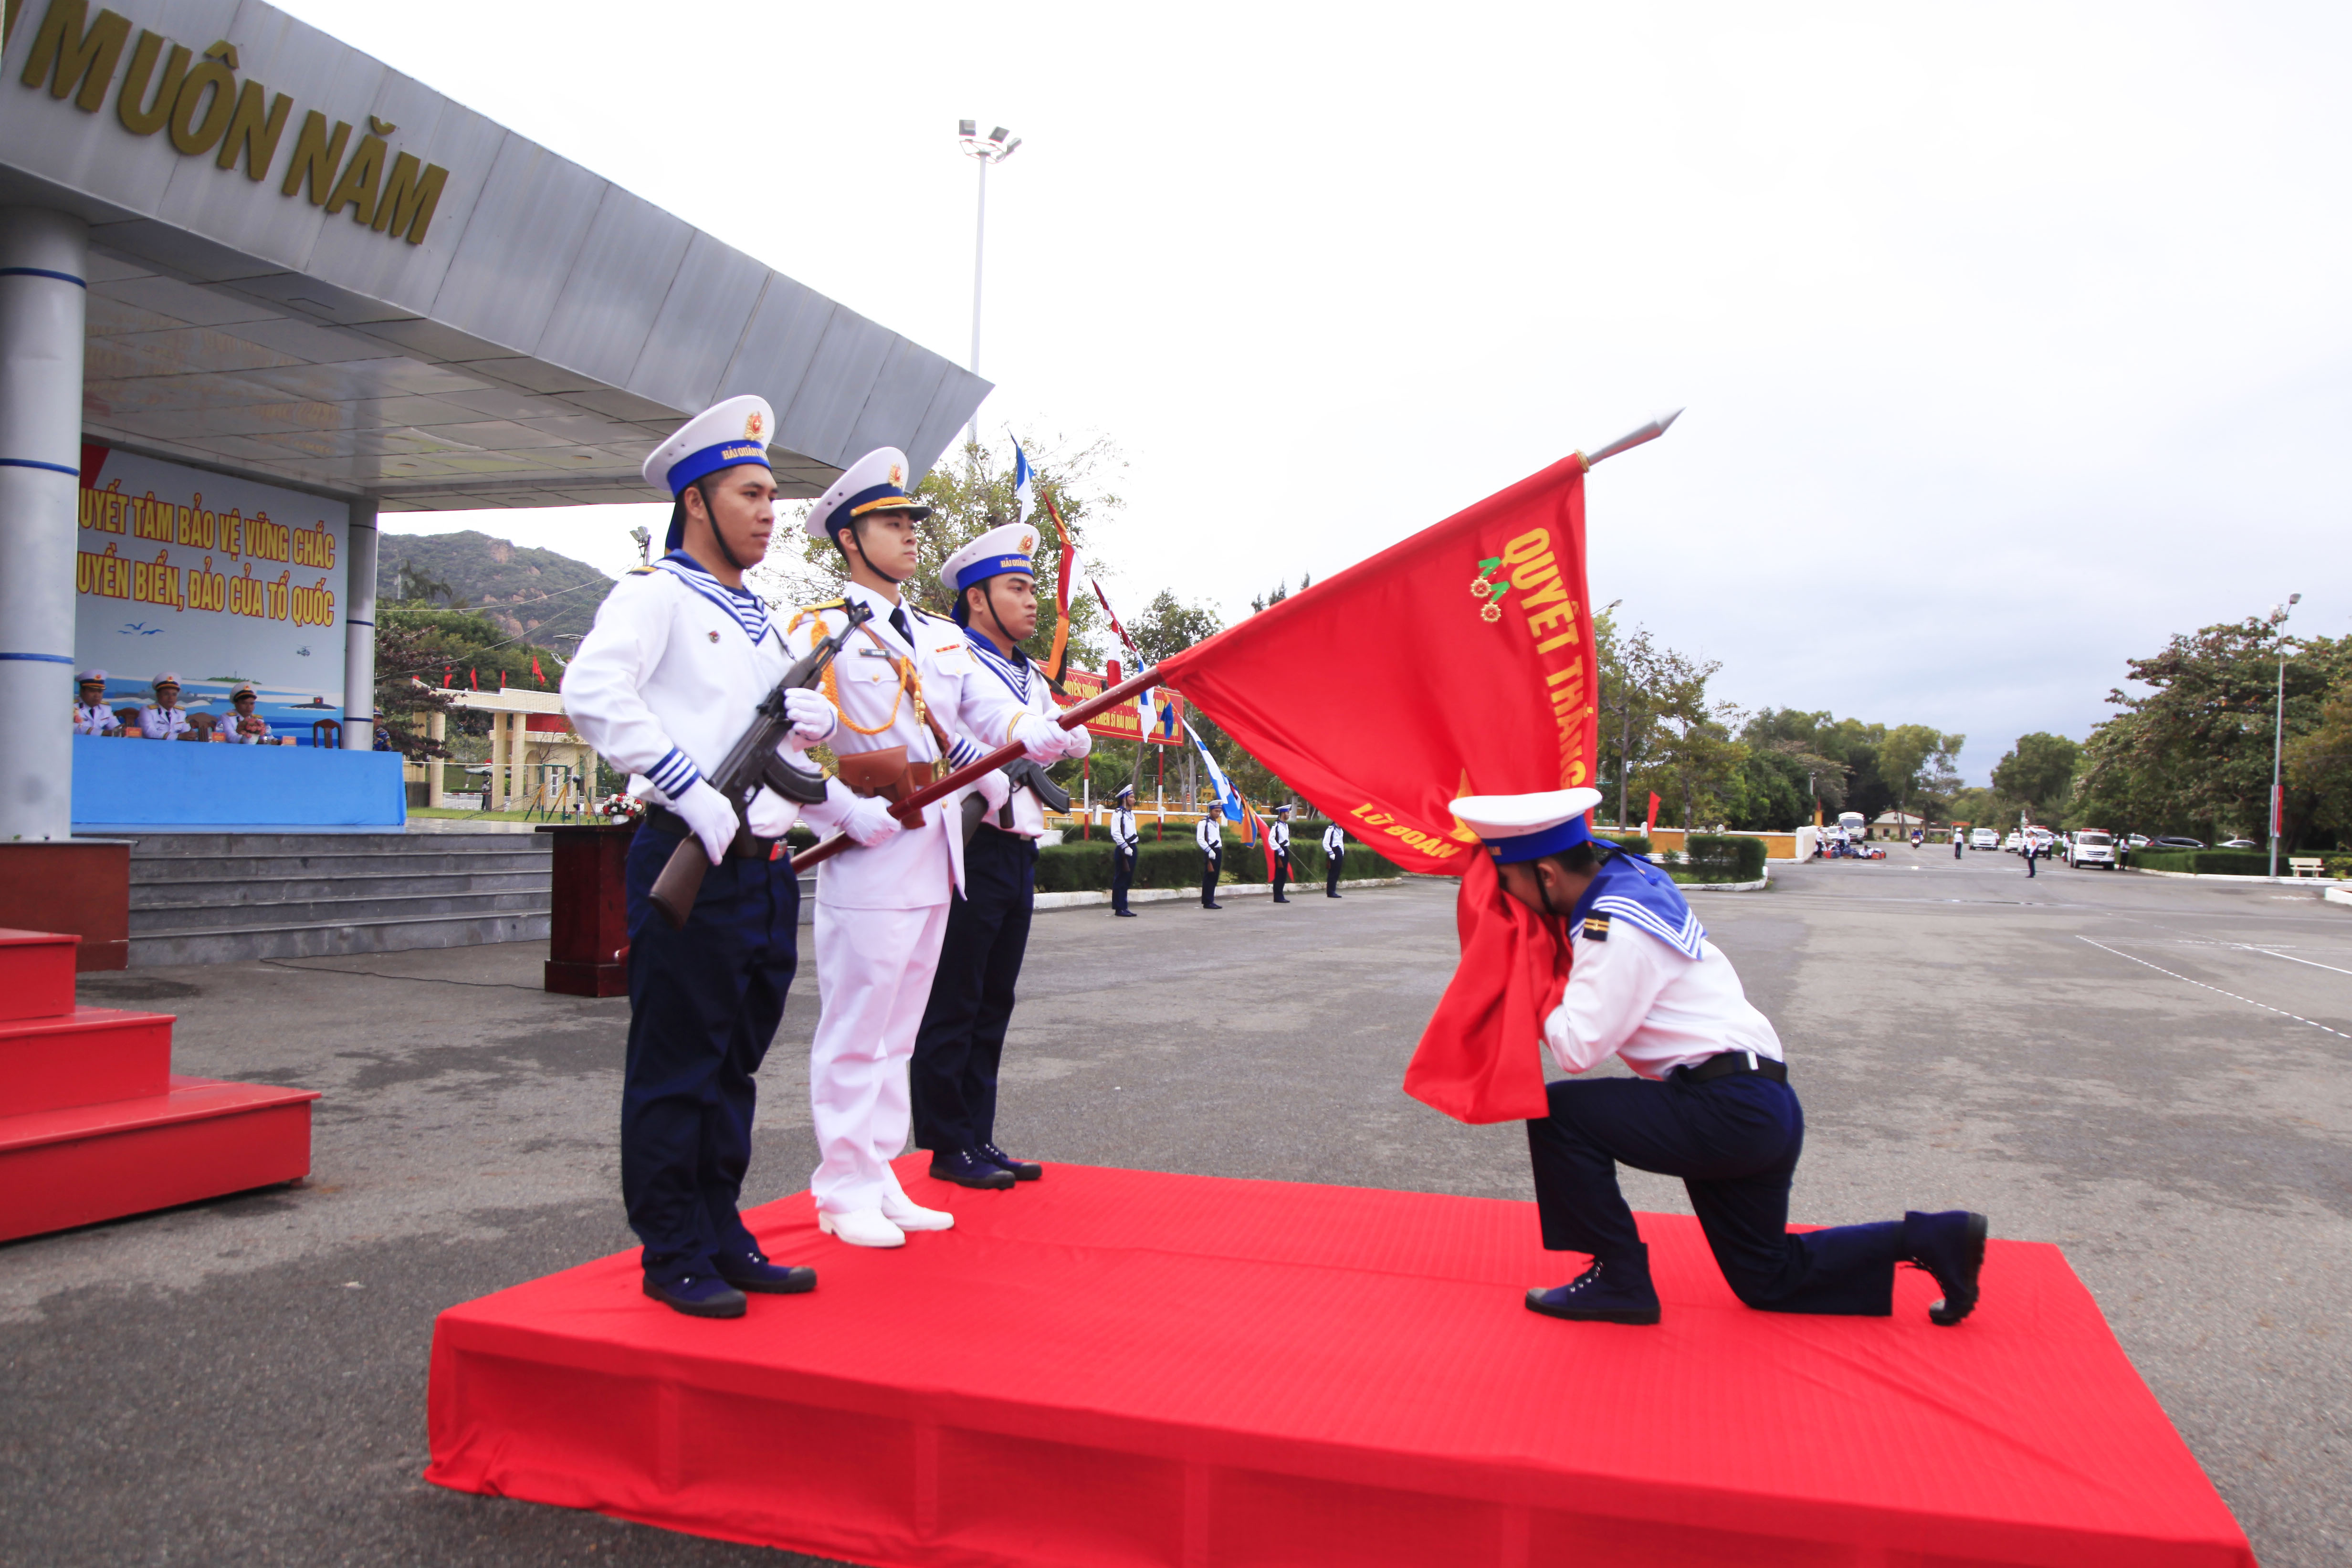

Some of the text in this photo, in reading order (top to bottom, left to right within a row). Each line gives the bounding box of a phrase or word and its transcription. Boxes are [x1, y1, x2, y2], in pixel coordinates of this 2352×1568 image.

[21, 0, 450, 245] MUÔN NĂM
[722, 446, 738, 460] HẢI
[737, 444, 759, 457] QUÂN
[79, 479, 336, 570] UYẾT TÂM BẢO VỆ VỮNG CHẮC
[77, 542, 335, 627] UYỀN BIỂN, ĐẢO CỦA TỔ QUỐC
[1000, 557, 1012, 568] HẢI
[1116, 711, 1124, 729] HẢI
[1546, 654, 1594, 790] THẮNG
[1350, 803, 1395, 825] LỮ
